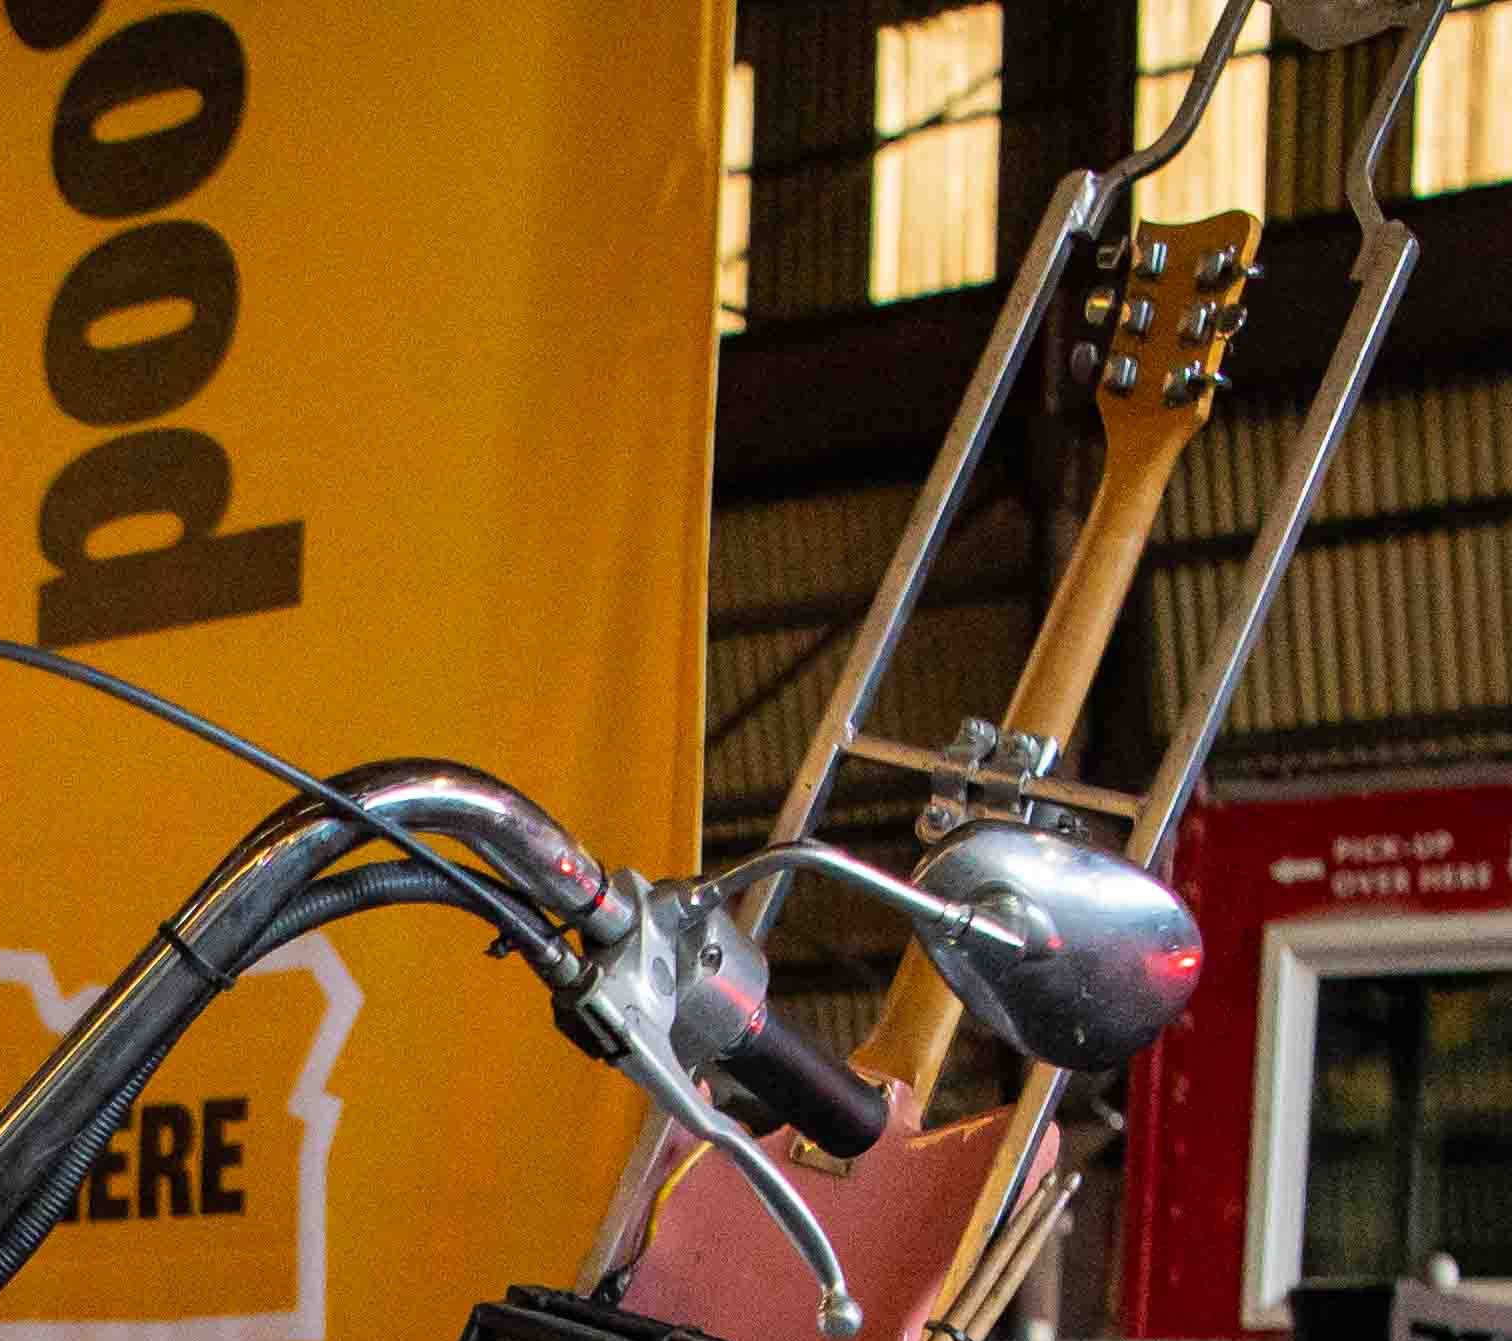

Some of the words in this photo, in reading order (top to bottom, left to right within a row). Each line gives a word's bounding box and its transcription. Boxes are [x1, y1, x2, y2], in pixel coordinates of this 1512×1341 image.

[2, 0, 305, 649] ood
[1329, 865, 1412, 898] OVER
[1417, 859, 1493, 894] HERE
[60, 1095, 250, 1225] ERE
